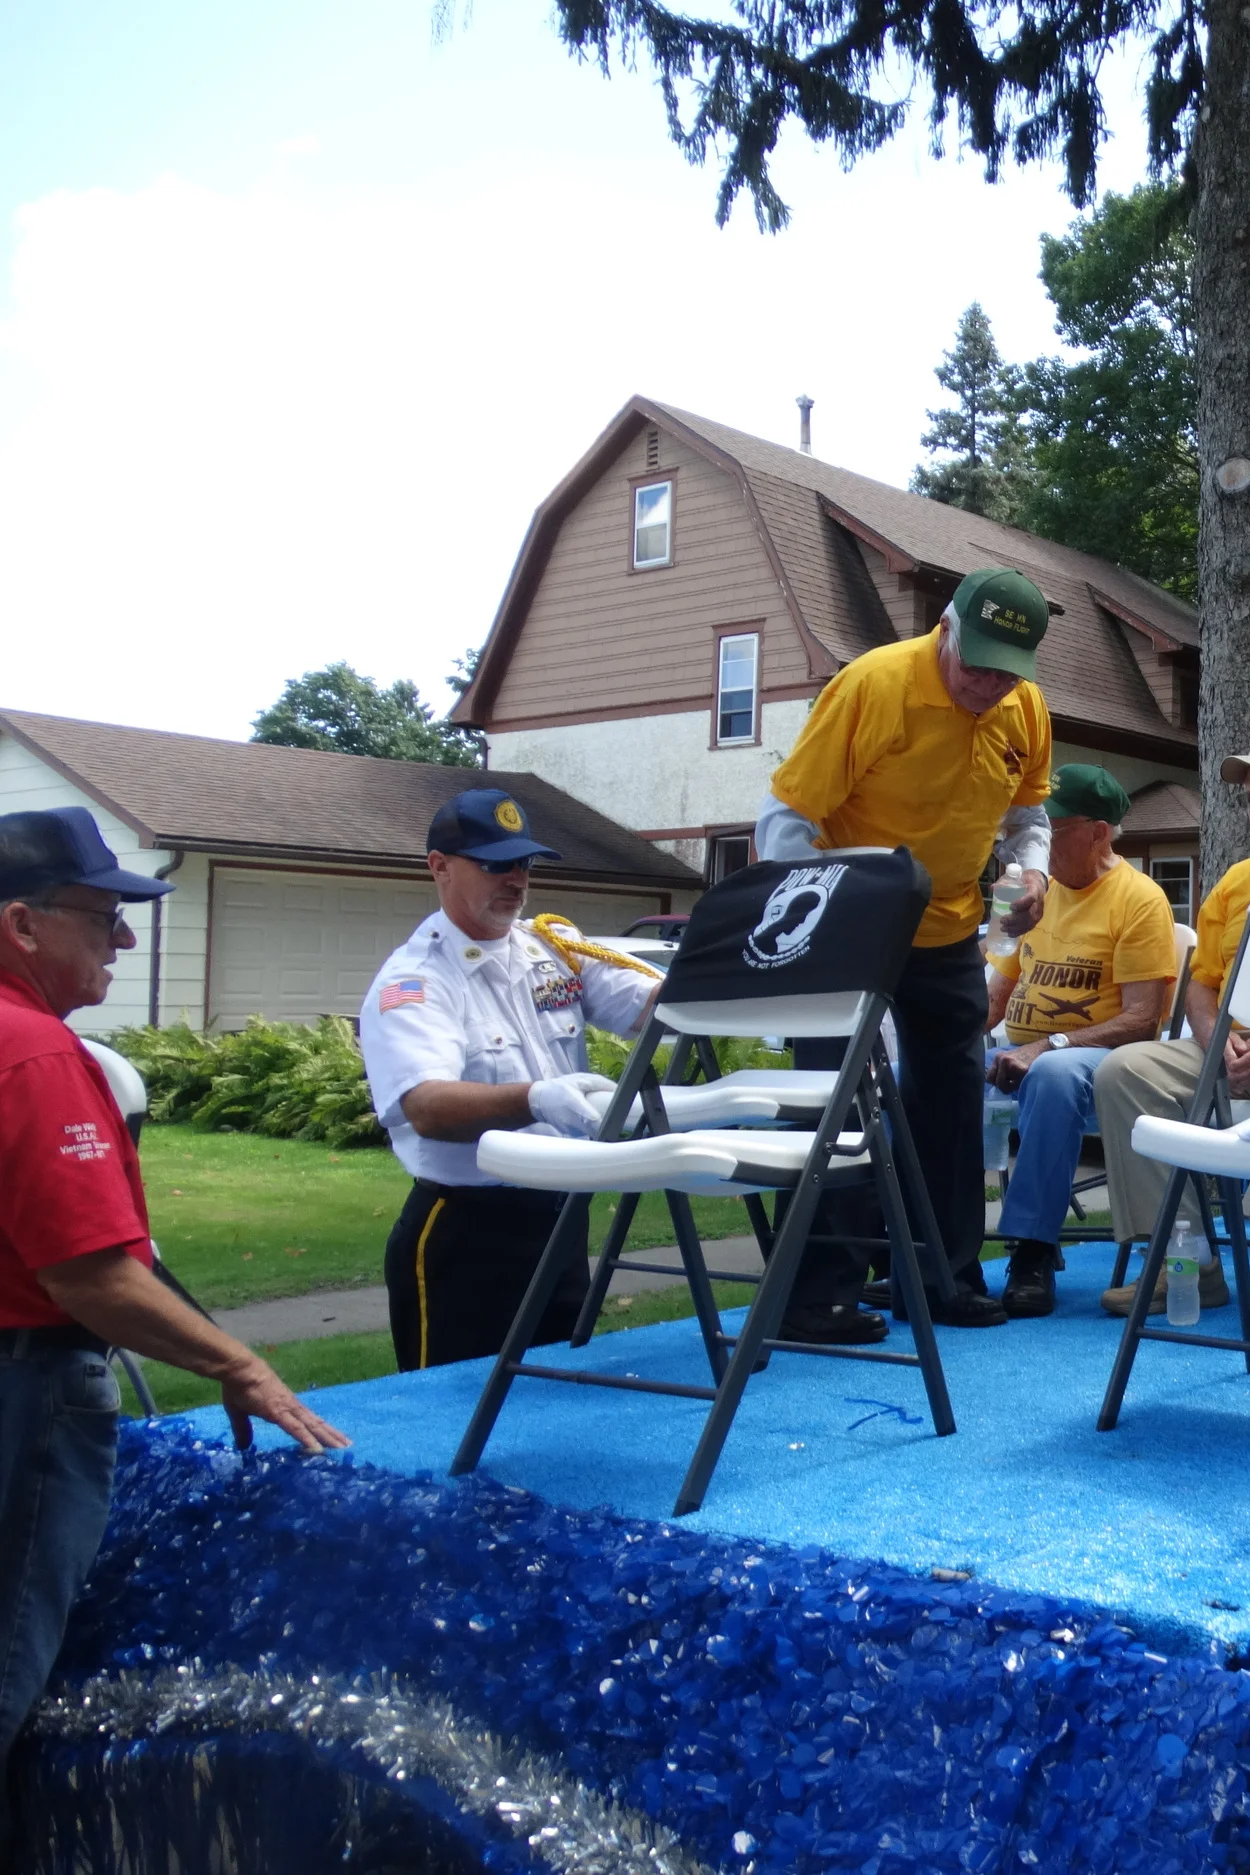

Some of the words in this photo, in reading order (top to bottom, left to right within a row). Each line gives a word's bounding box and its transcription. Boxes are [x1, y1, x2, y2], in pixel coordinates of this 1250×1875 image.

[993, 615, 1013, 629] HONOR
[1066, 955, 1103, 966] Veteran
[1029, 963, 1102, 991] HONOR
[1006, 999, 1037, 1025] GHT
[59, 1143, 93, 1155] Vietnam
